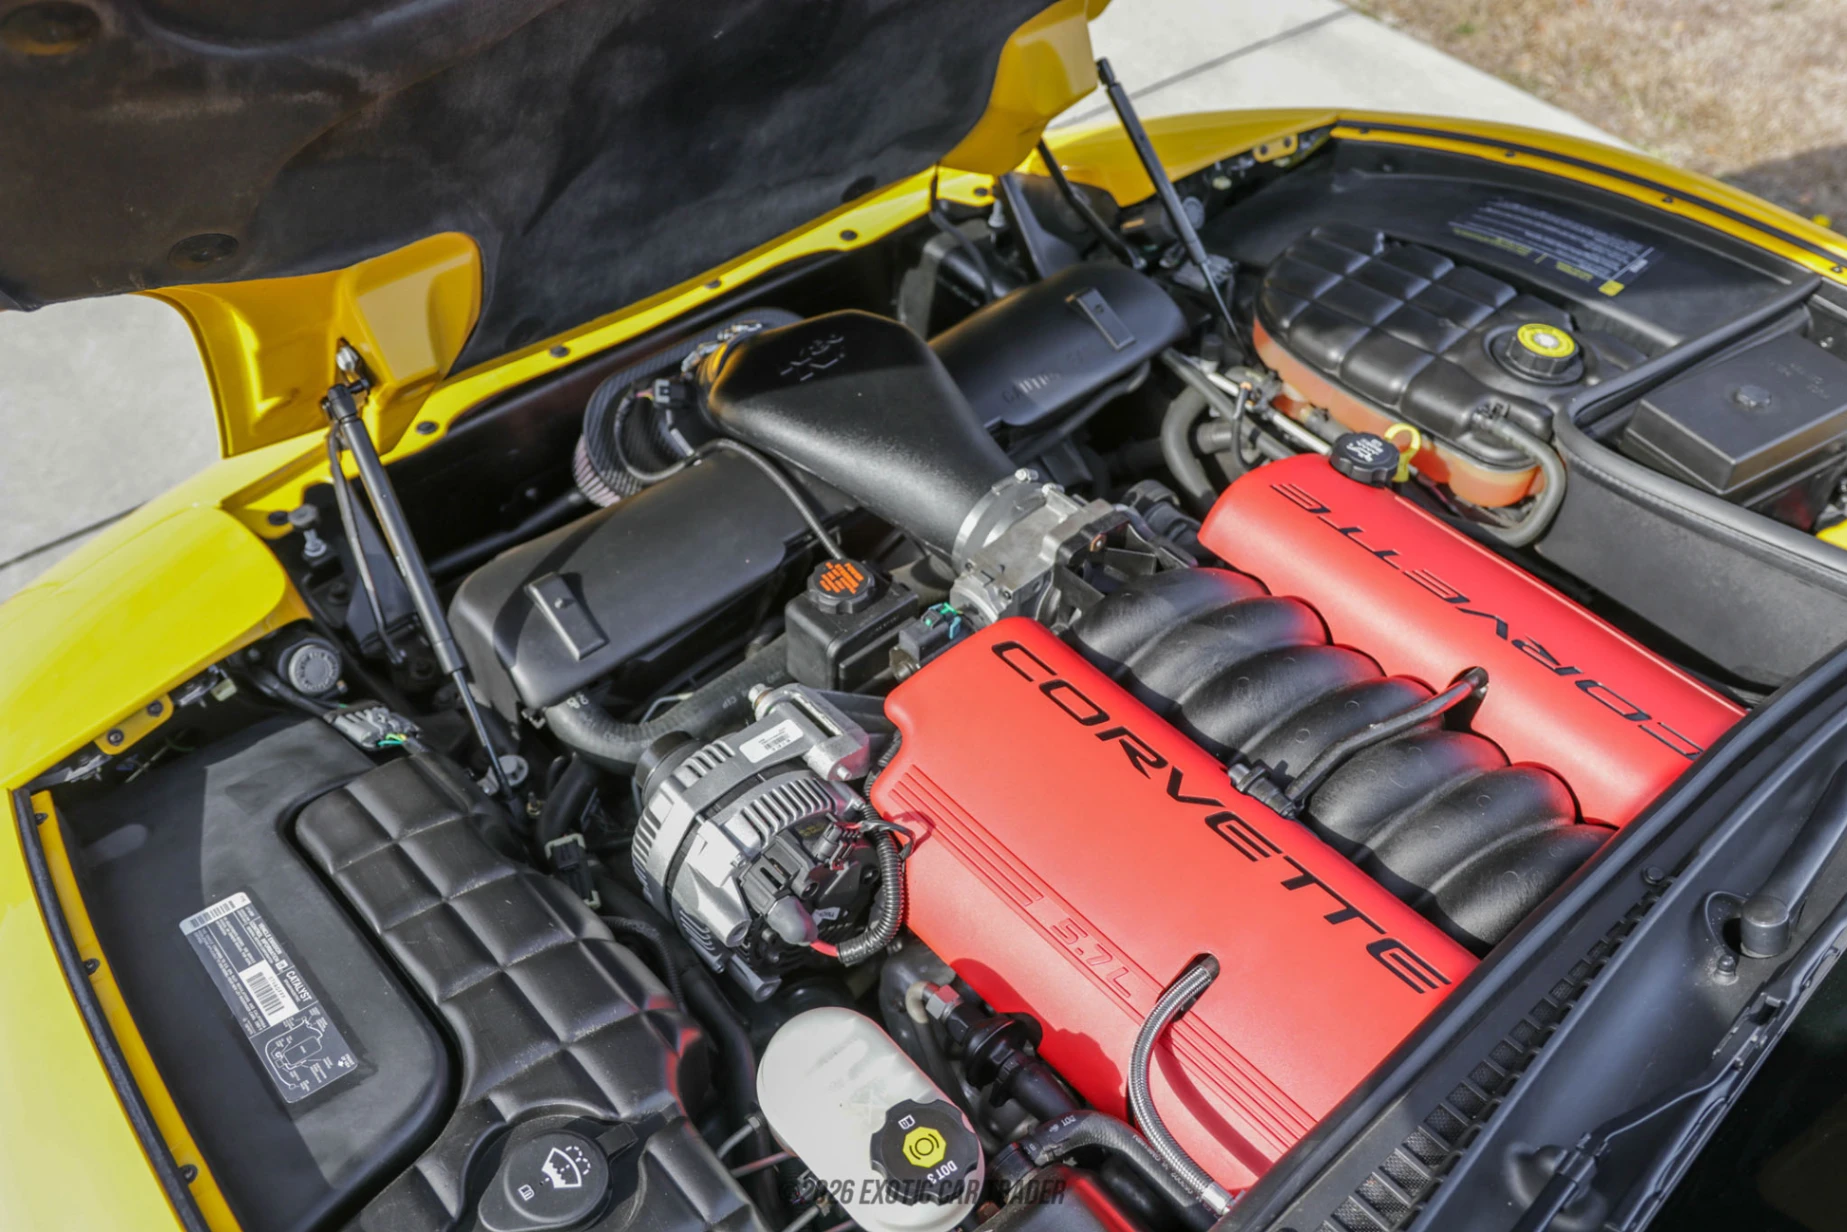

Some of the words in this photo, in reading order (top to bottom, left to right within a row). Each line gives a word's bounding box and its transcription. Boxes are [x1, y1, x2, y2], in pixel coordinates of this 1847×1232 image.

[1270, 482, 1704, 761] CORVETTE
[991, 640, 1452, 994] CORVETTE
[285, 969, 312, 1002] CATALYST
[1050, 918, 1131, 998] 5.7L
[927, 1173, 937, 1186] 3
[935, 1160, 957, 1179] DOT
